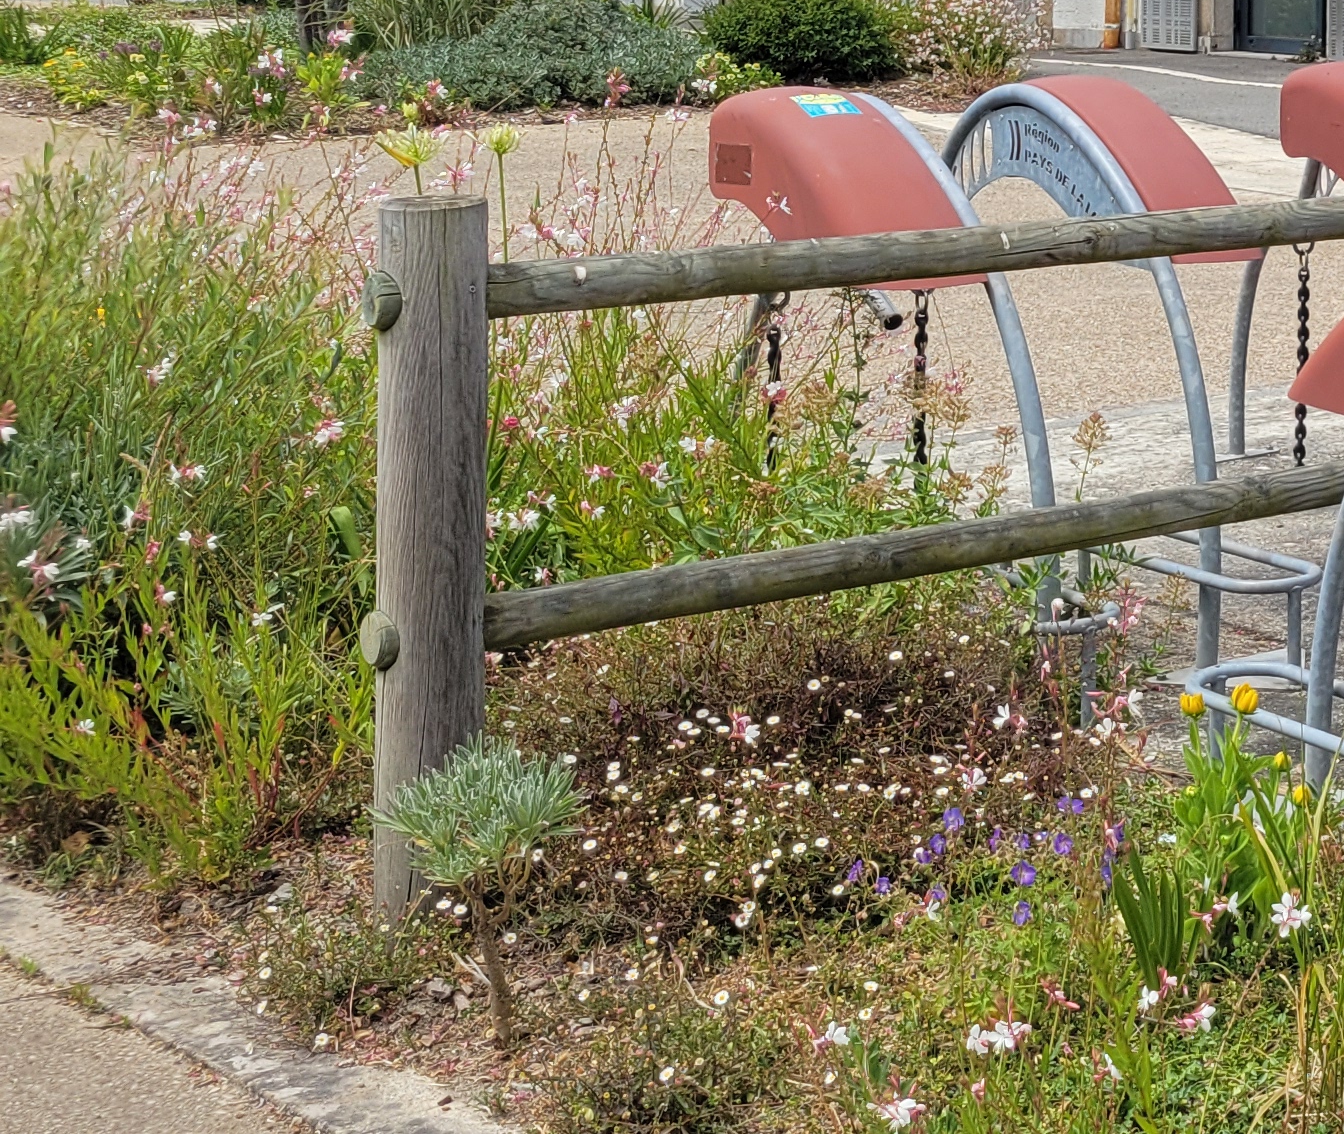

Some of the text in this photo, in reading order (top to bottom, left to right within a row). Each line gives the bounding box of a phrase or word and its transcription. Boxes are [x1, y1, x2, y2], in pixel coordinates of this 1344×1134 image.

[1024, 123, 1060, 153] Région
[1025, 149, 1084, 207] PAYS DE LA
